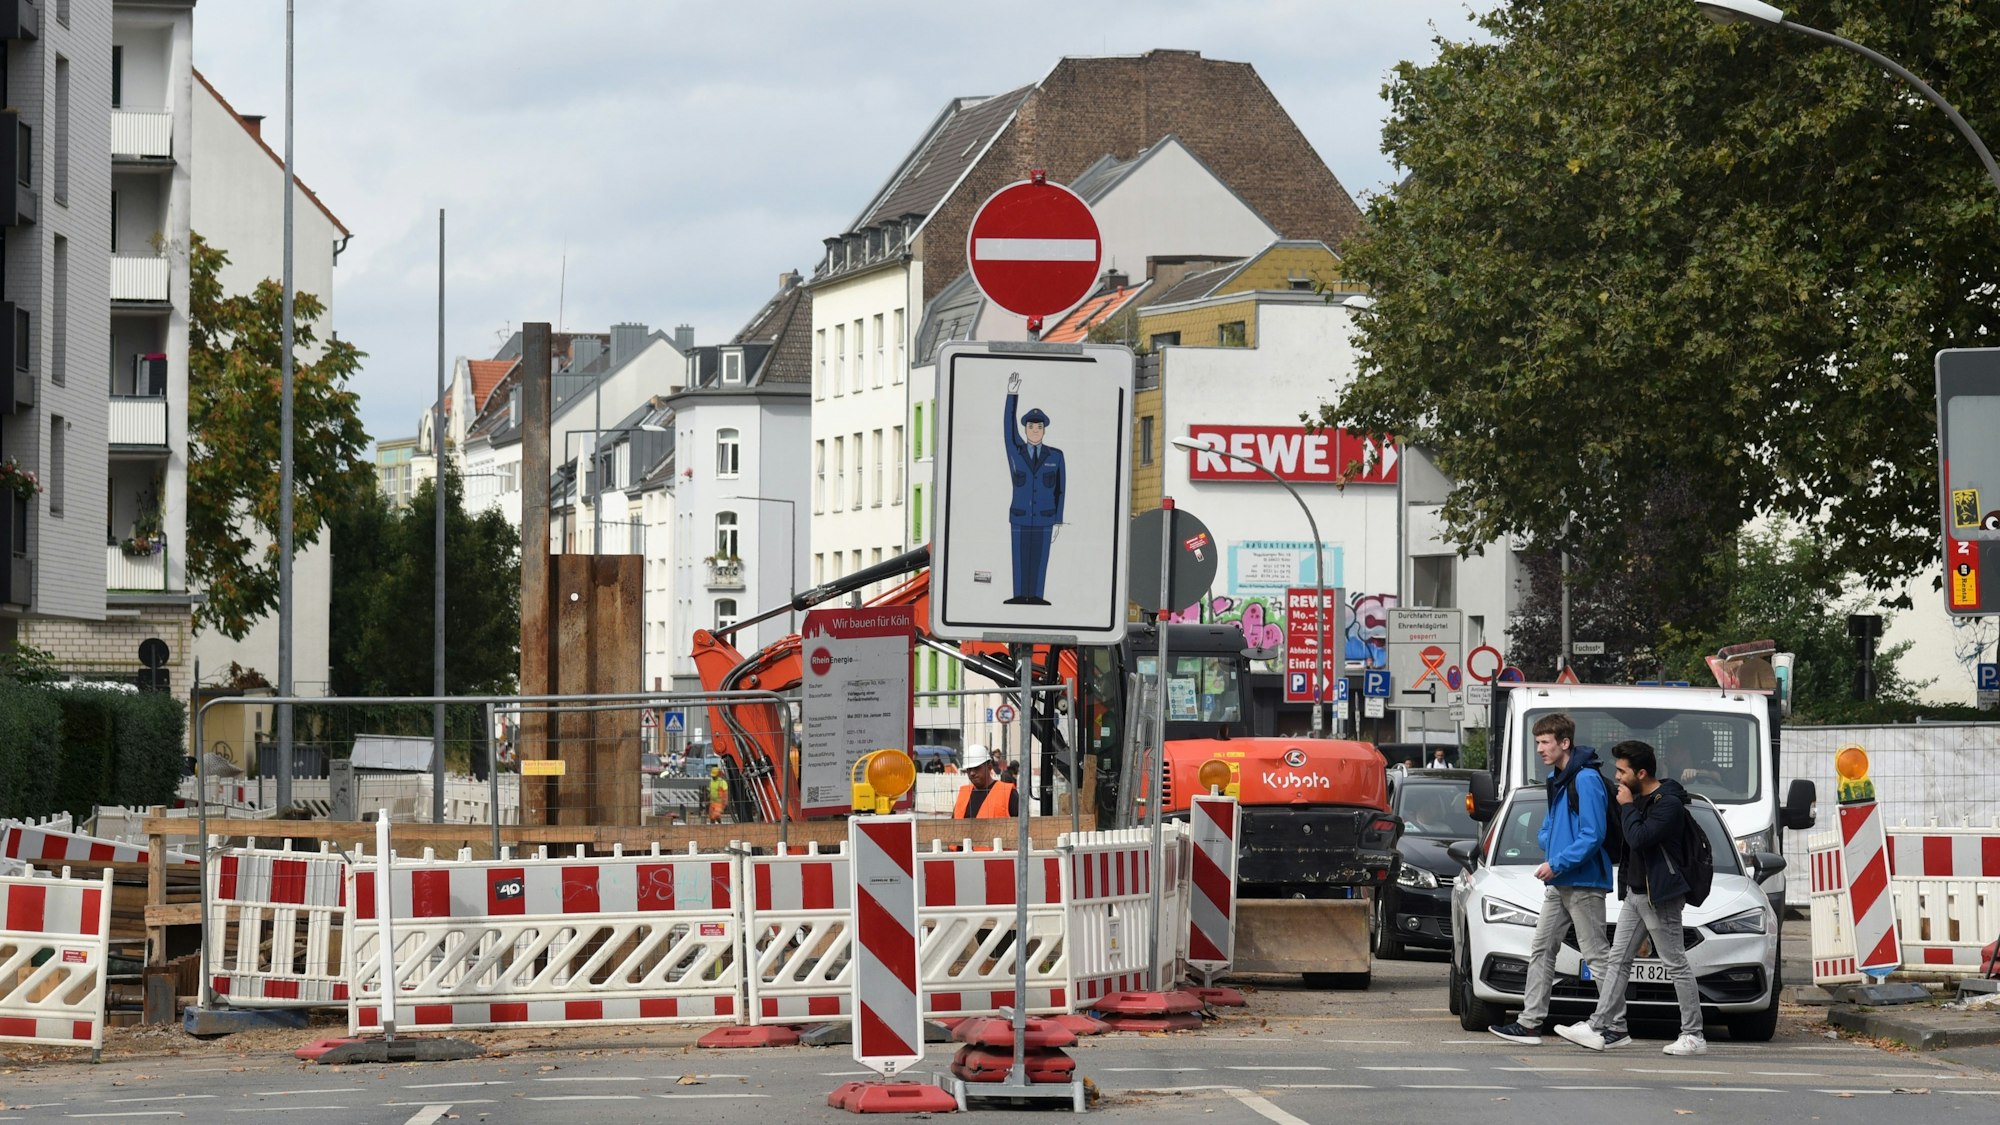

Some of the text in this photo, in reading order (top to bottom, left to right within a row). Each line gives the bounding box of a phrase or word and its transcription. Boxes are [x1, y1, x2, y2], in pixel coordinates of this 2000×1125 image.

[1197, 432, 1330, 474] REWE
[1290, 595, 1332, 608] REWE
[832, 614, 910, 629] Wir bauen für Köln
[1398, 622, 1448, 630] Ehrenfeldgürtel
[812, 656, 853, 665] RheinEnergie
[1292, 674, 1304, 692] P
[1368, 673, 1384, 693] P
[1982, 666, 1997, 687] P
[1339, 681, 1345, 698] P
[1262, 772, 1330, 788] Kubota
